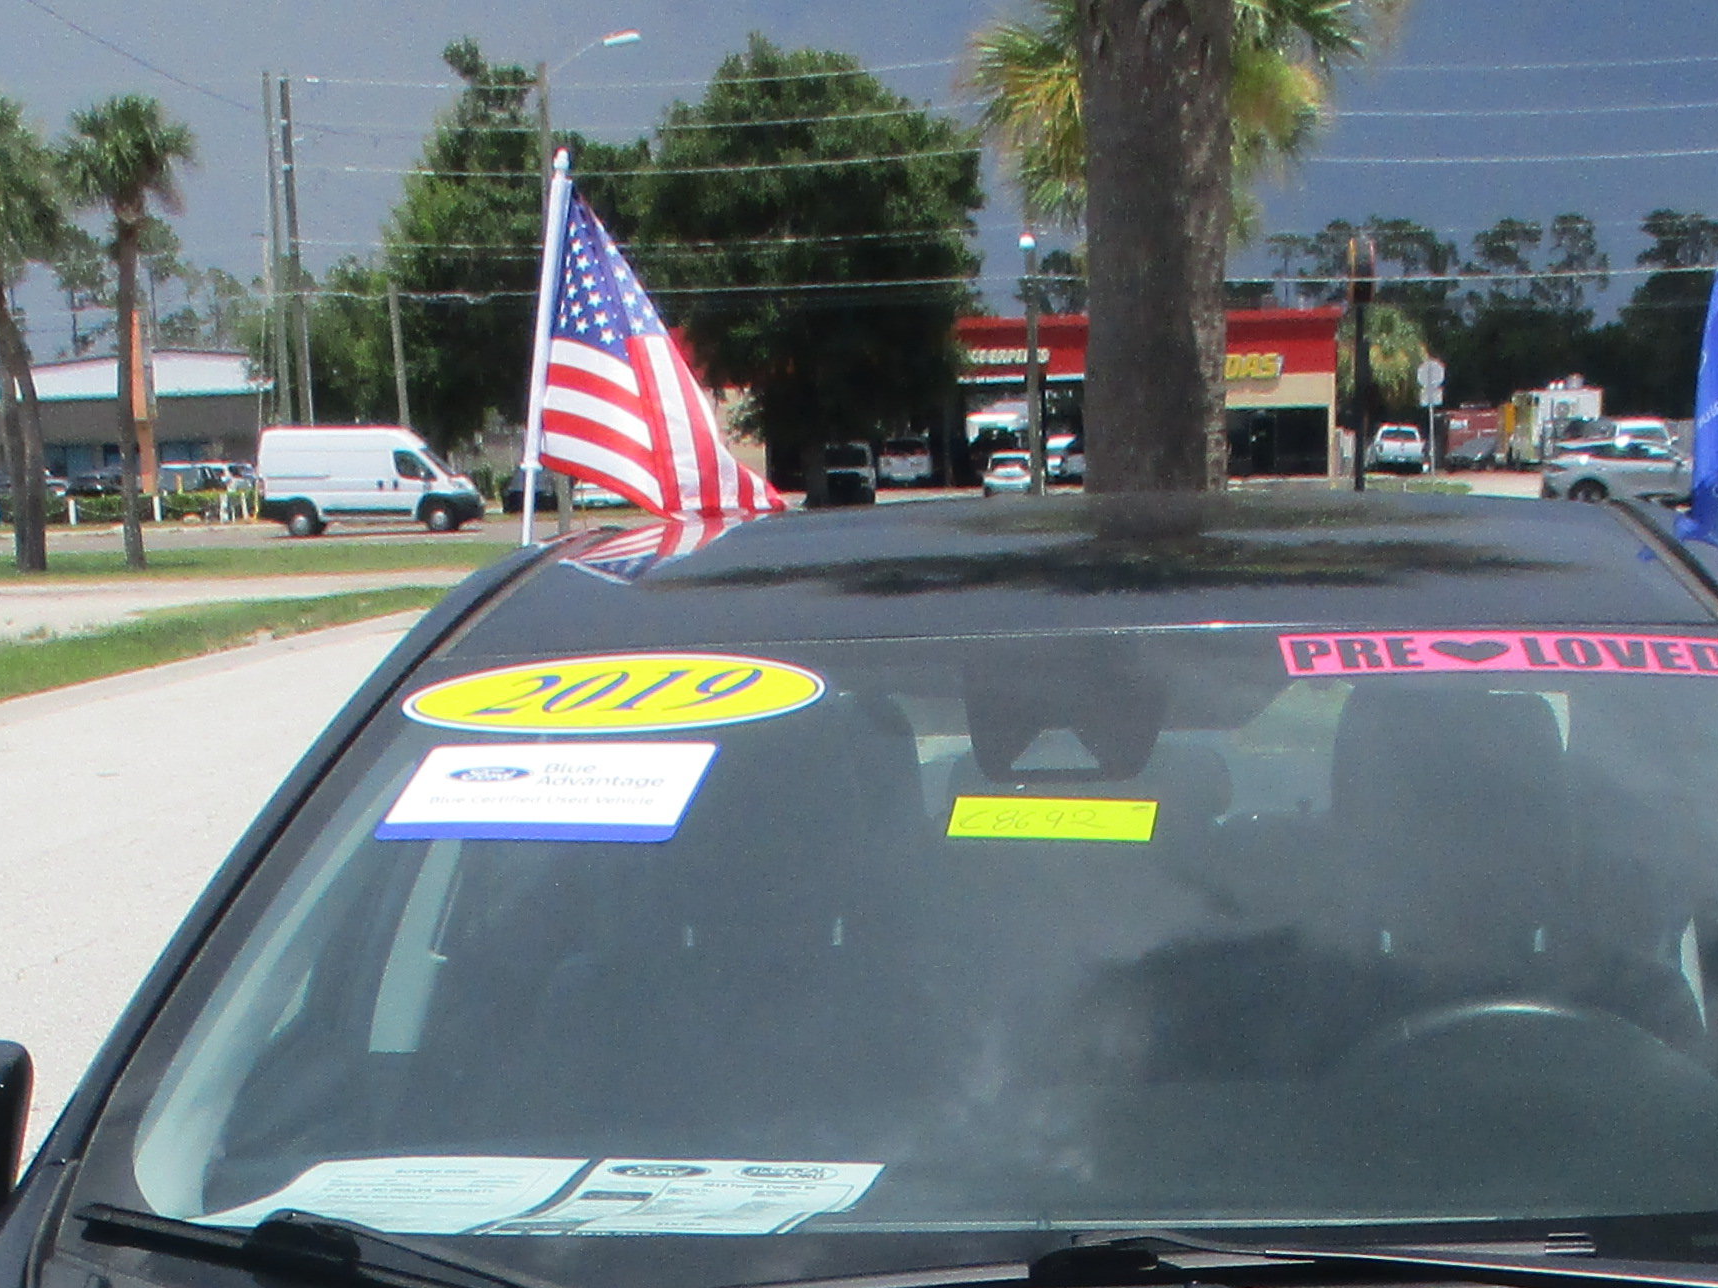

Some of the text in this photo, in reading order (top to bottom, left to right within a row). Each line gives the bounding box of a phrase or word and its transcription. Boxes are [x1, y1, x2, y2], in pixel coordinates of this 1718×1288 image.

[1224, 353, 1278, 379] DAS
[1289, 637, 1425, 671] PRE
[464, 667, 763, 717] 2019
[542, 762, 598, 774] Blue
[535, 775, 666, 789] Advantage
